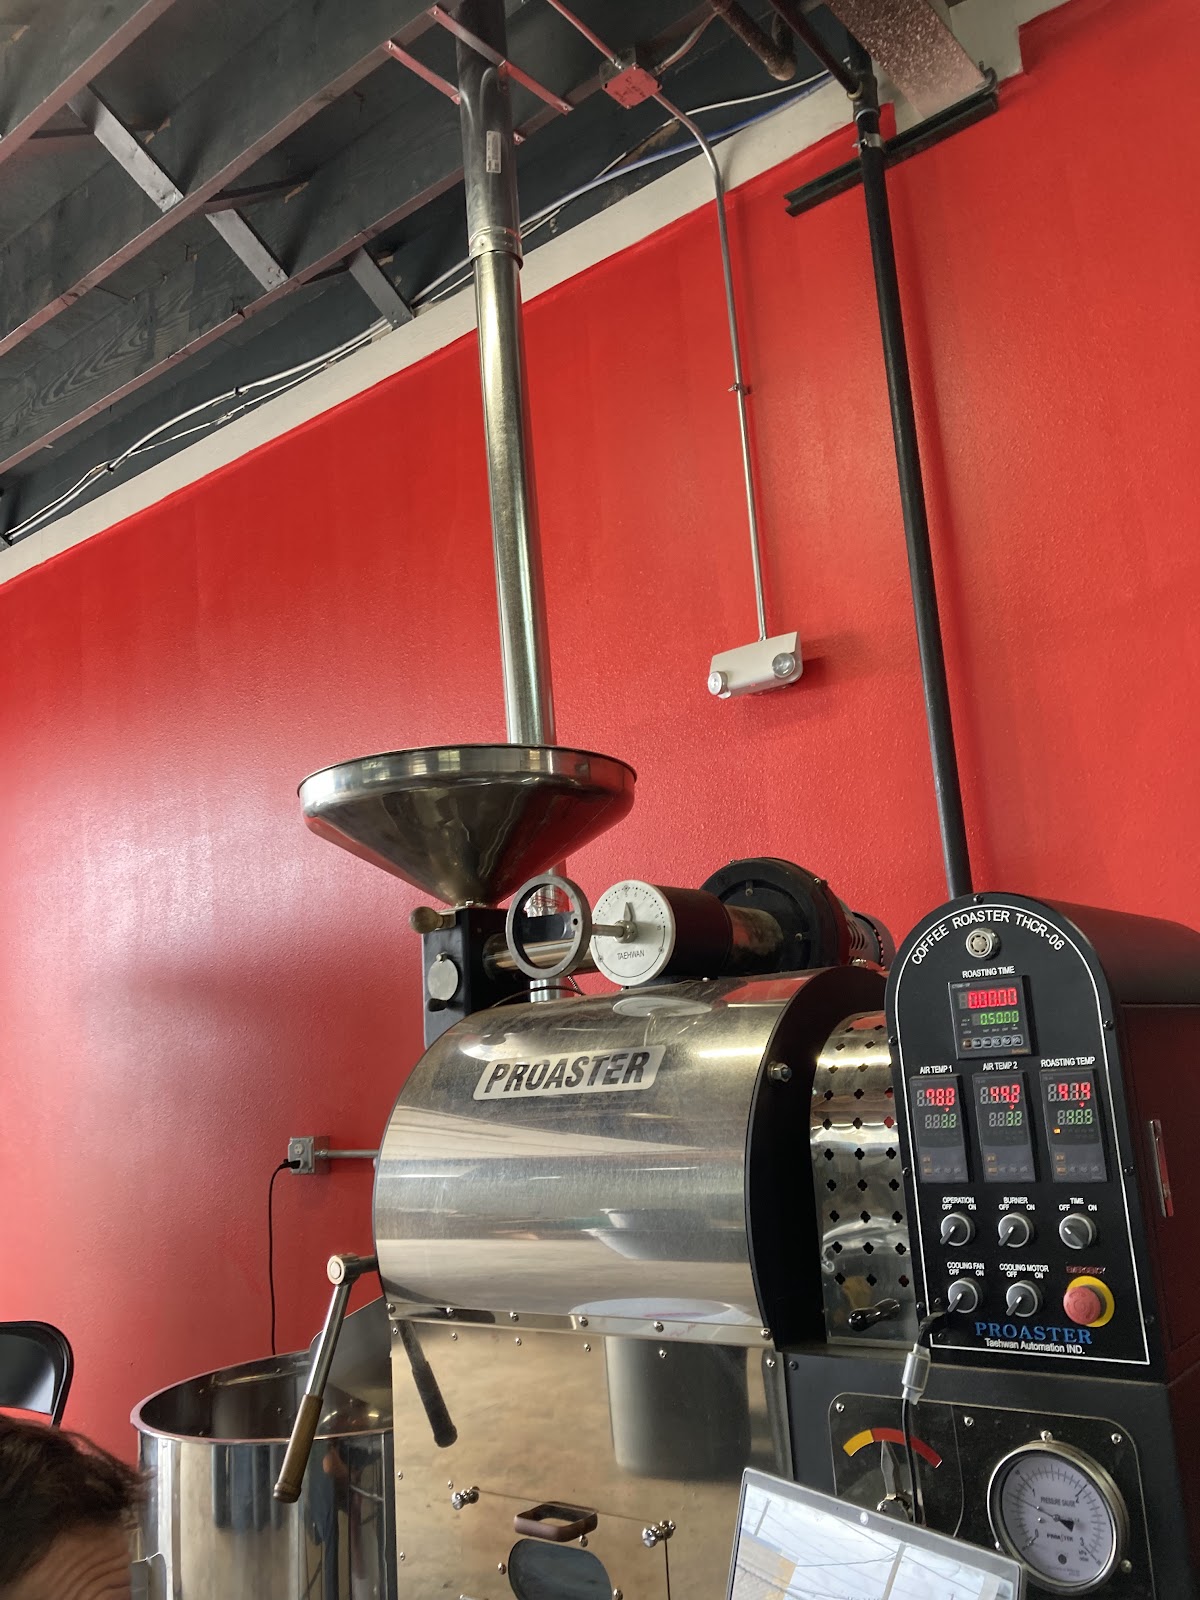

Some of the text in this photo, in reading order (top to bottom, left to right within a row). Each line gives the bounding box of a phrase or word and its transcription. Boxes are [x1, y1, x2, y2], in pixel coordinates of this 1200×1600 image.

[911, 910, 1065, 965] COFFEE ROASTER THCR-06
[617, 950, 645, 960] TAEHWAN
[962, 965, 1015, 979] ROASTING TIME
[983, 1061, 1018, 1071] AIR TEMP 2
[1041, 1056, 1096, 1068] ROASTING TEMP
[484, 1051, 650, 1093] PROASTER
[920, 1066, 931, 1074] AIR
[932, 1065, 948, 1073] TEMP
[942, 1196, 975, 1204] OPERATION
[1003, 1196, 1028, 1204] BURNER
[1070, 1197, 1084, 1205] TIME
[1088, 1204, 1097, 1212] ON
[947, 1261, 985, 1270] COOLING FAN
[999, 1263, 1050, 1273] COOLING MOTOR
[975, 1269, 984, 1277] ON
[1006, 1270, 1018, 1278] OFF
[975, 1321, 1093, 1345] PROASTER
[984, 1337, 1085, 1354] Taehwan Automation IND.
